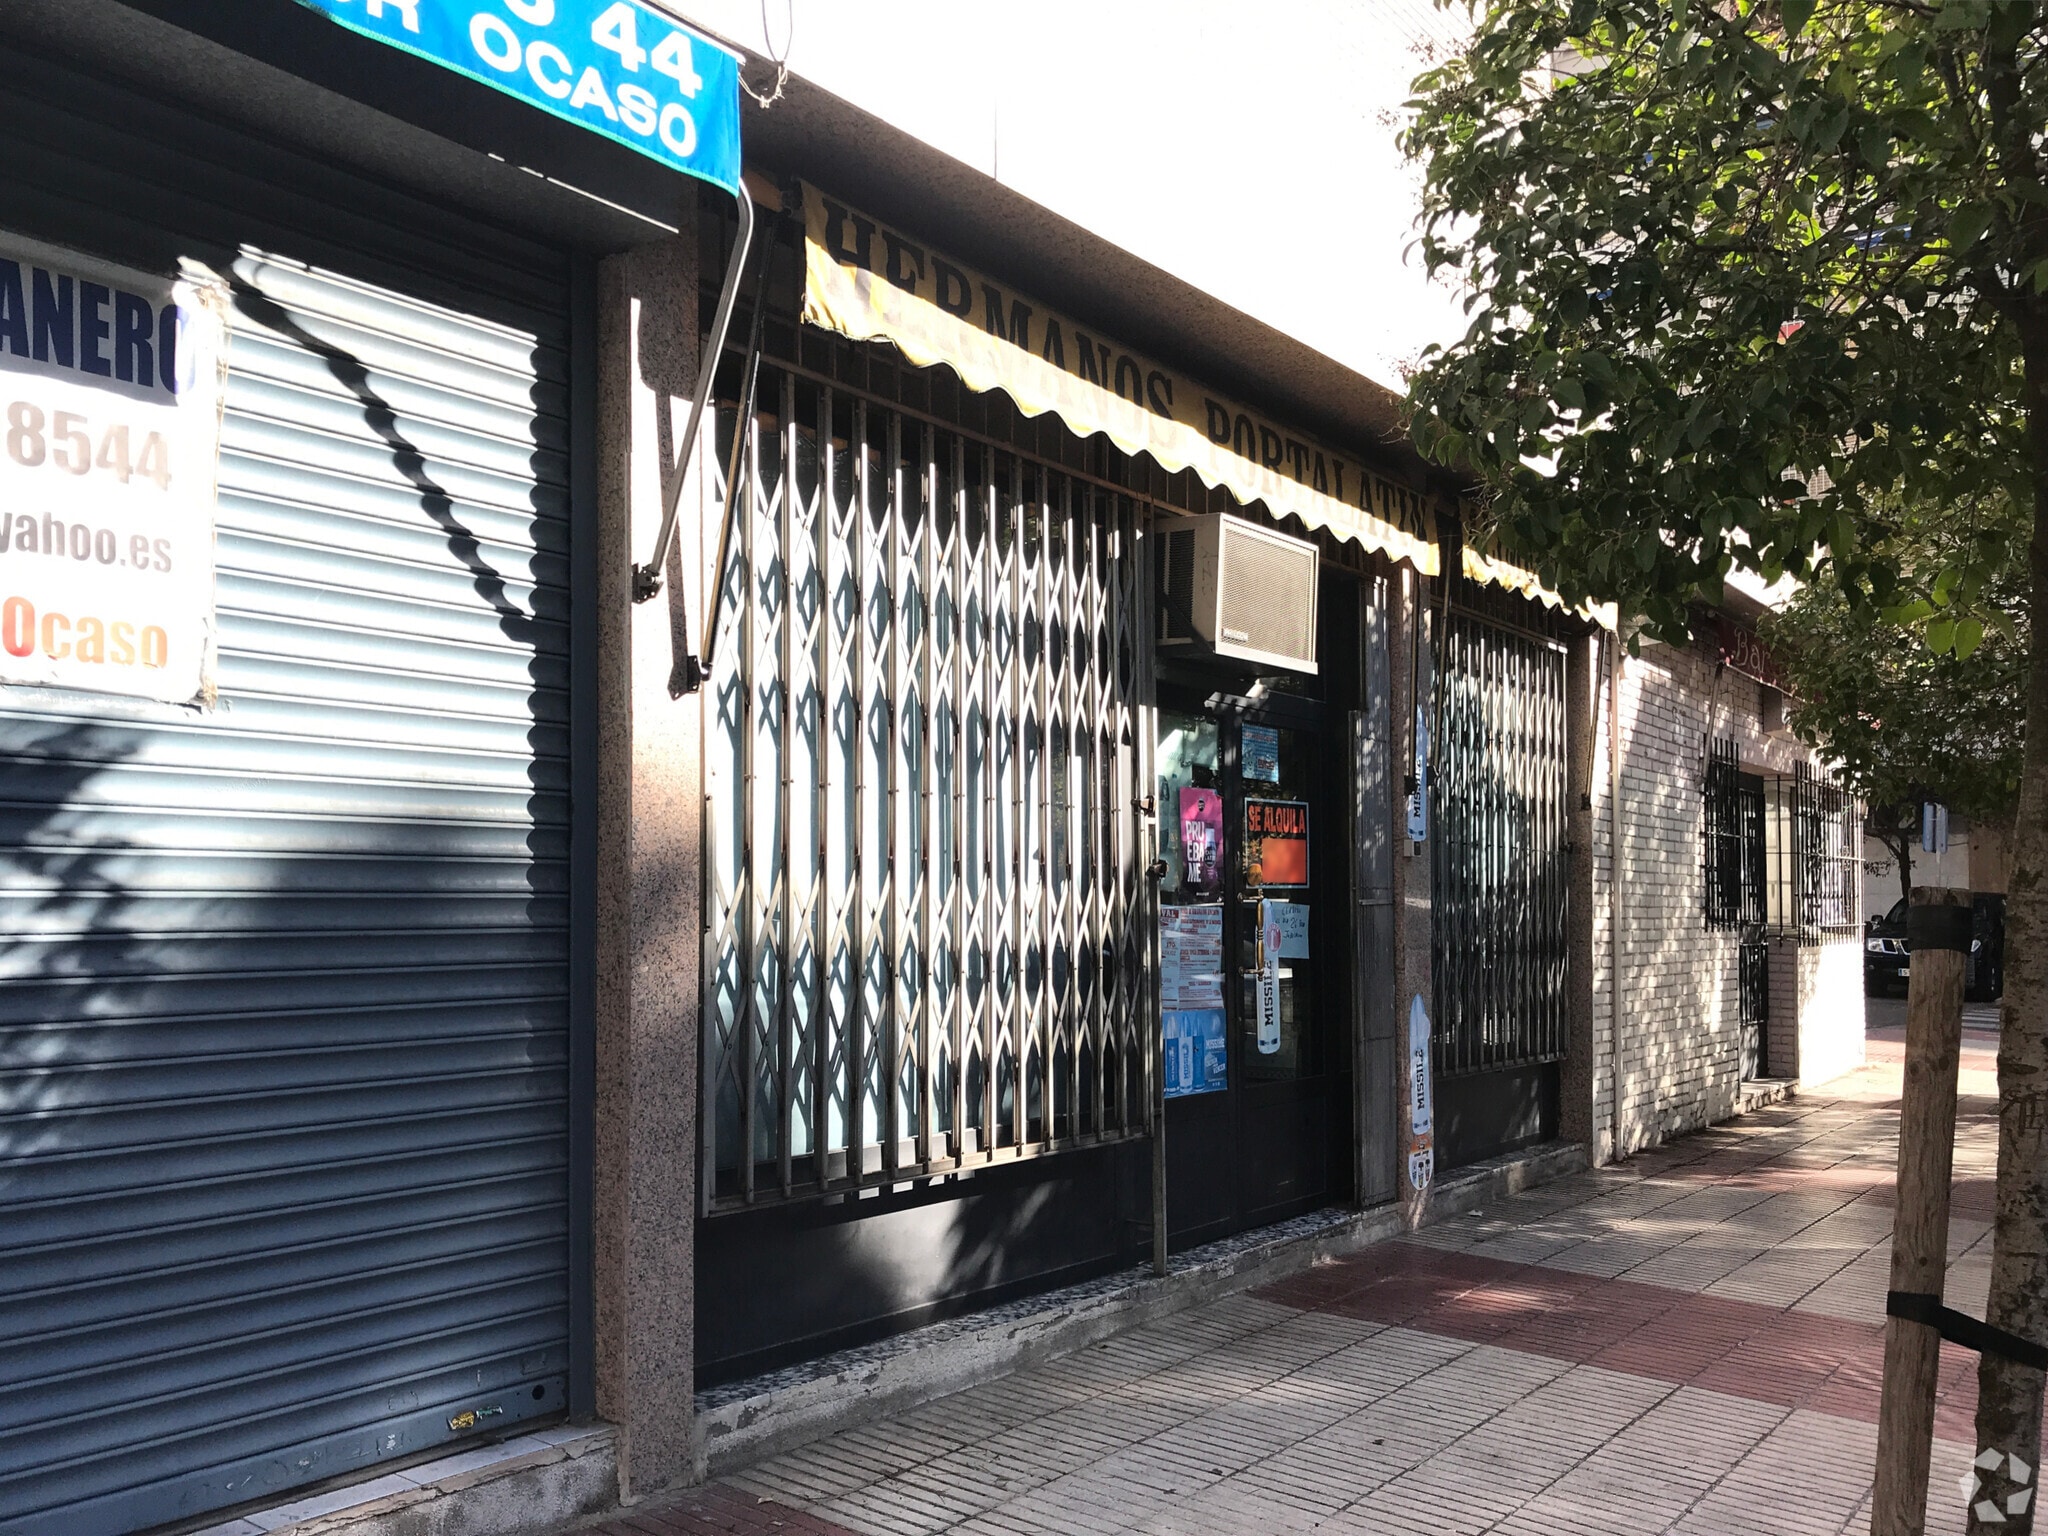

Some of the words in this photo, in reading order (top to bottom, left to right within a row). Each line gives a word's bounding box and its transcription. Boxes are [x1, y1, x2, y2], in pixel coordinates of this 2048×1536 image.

[591, 1, 702, 99] 44
[468, 12, 698, 158] OCASO
[822, 197, 1177, 448] HERMANOS
[6, 400, 172, 491] 8544
[2, 596, 168, 669] Ocaso
[1731, 626, 1771, 674] Bar
[1186, 820, 1205, 840] PRU
[1248, 804, 1261, 832] SE
[1264, 805, 1306, 834] ALQUILA
[1187, 841, 1205, 862] EBA
[1187, 862, 1201, 882] ME
